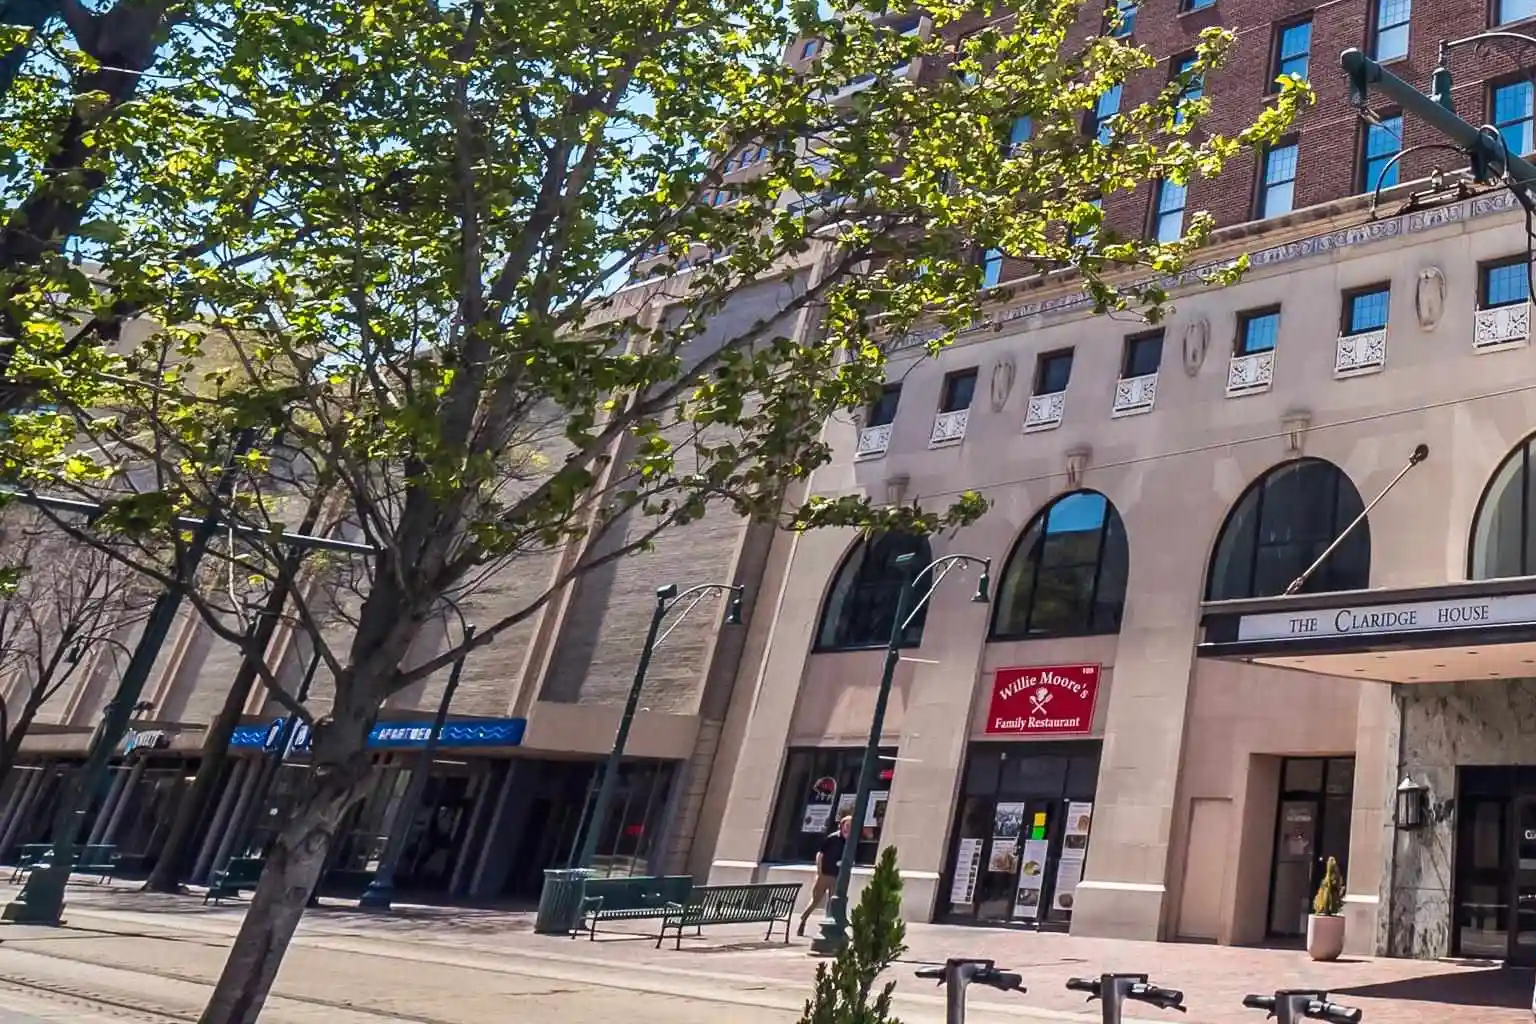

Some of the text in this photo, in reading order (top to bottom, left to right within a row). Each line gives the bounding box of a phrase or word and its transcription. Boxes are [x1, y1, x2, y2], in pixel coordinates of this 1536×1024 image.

[1289, 605, 1489, 633] THE CLARIDGE HOUSE
[1000, 671, 1089, 701] Willie Moore's
[994, 716, 1081, 731] Family Restaurant
[378, 728, 444, 741] APARTMENS
